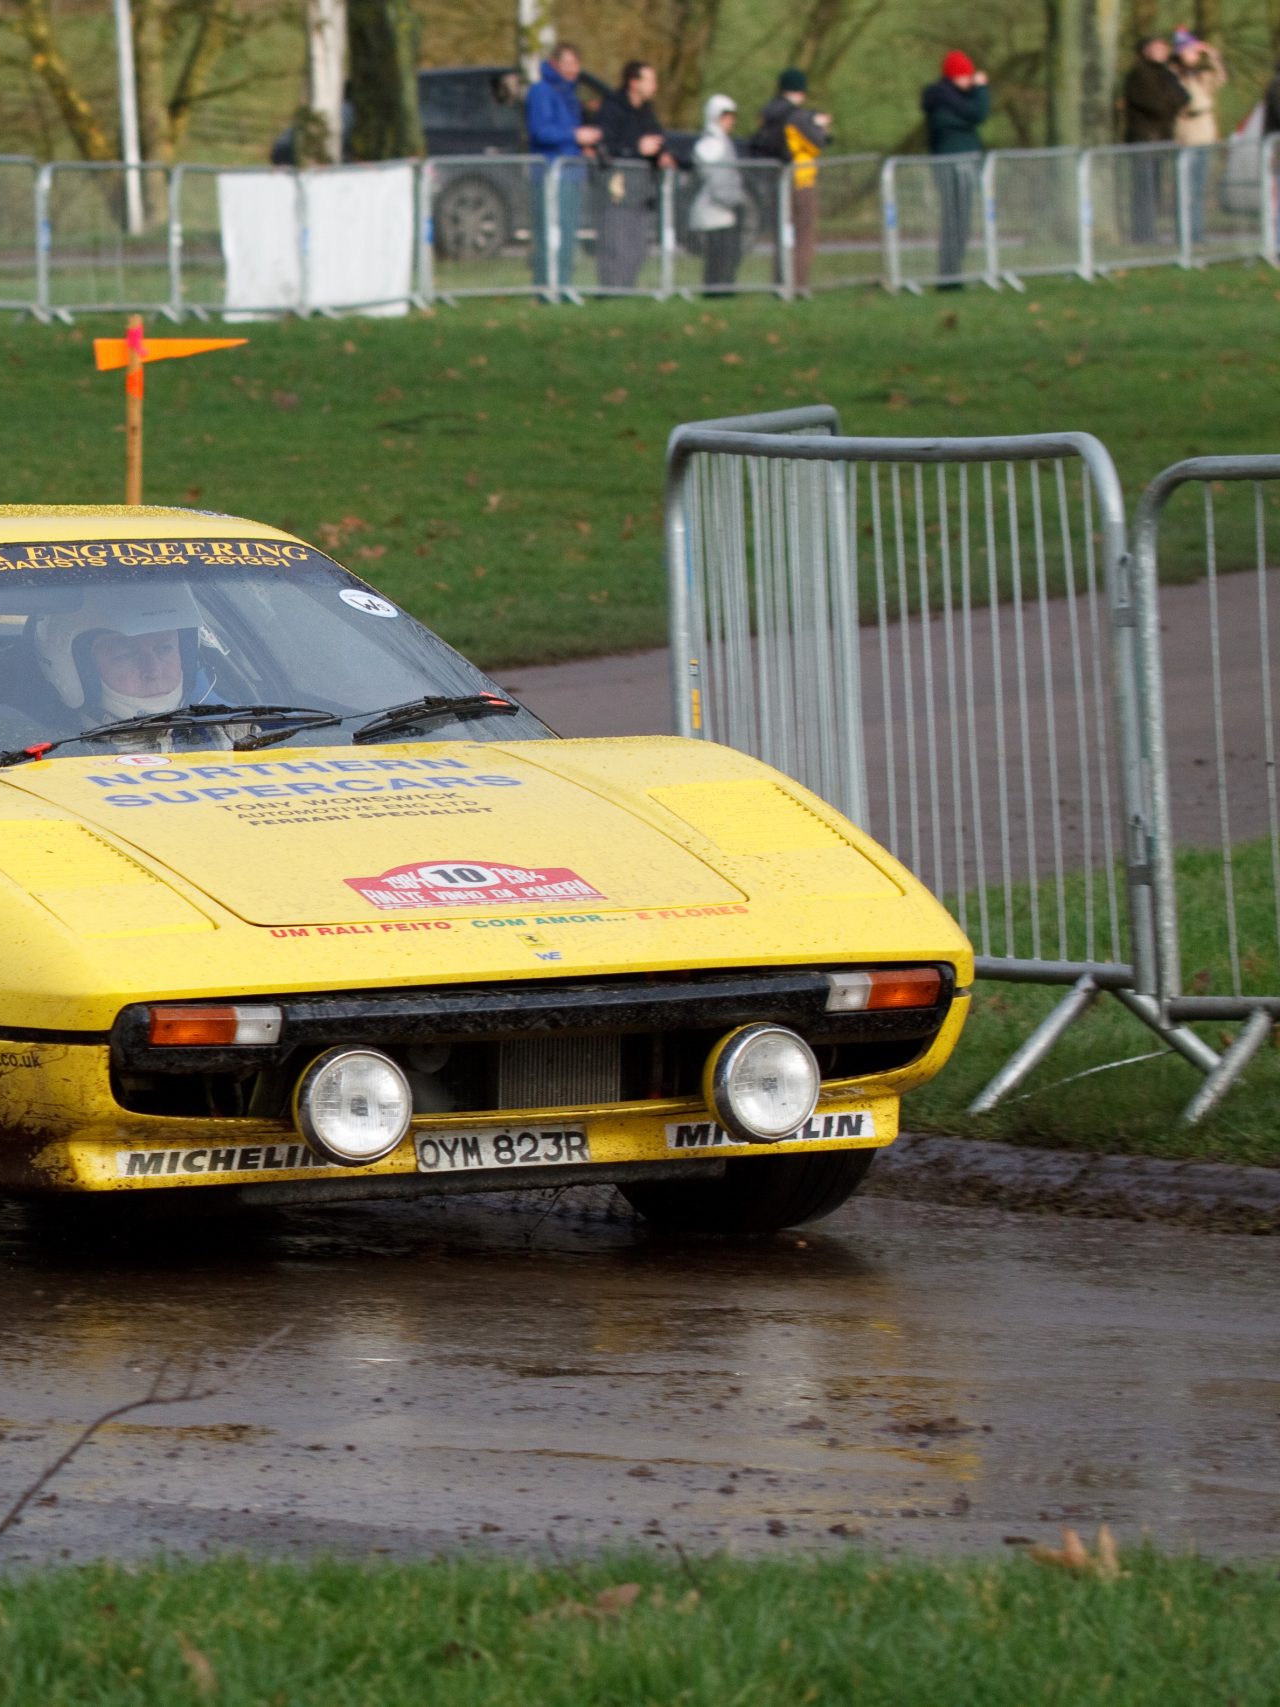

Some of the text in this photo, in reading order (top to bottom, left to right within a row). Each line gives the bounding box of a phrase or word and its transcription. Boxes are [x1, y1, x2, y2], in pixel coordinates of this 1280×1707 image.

[25, 541, 310, 561] ENGINEERING
[119, 556, 189, 566] 0254
[204, 556, 291, 567] 261351
[85, 758, 471, 787] NORTHERN
[104, 774, 523, 808] SUPERCARS
[216, 792, 465, 812] TONY WORSWICK
[236, 799, 479, 820] AUTOMOTIVE ENG LTD
[248, 807, 494, 826] FERRARI SPECIALIST
[429, 867, 487, 884] 10
[360, 889, 427, 904] RALLYE
[429, 889, 488, 901] VINHO
[488, 888, 515, 898] DA
[523, 879, 597, 897] MADEIRA
[470, 914, 627, 928] COM AMOR...
[635, 905, 750, 920] E FLORES
[270, 921, 452, 938] UM RALI FEITO
[675, 1113, 863, 1148] MILIN
[420, 1131, 588, 1169] OYM 823R
